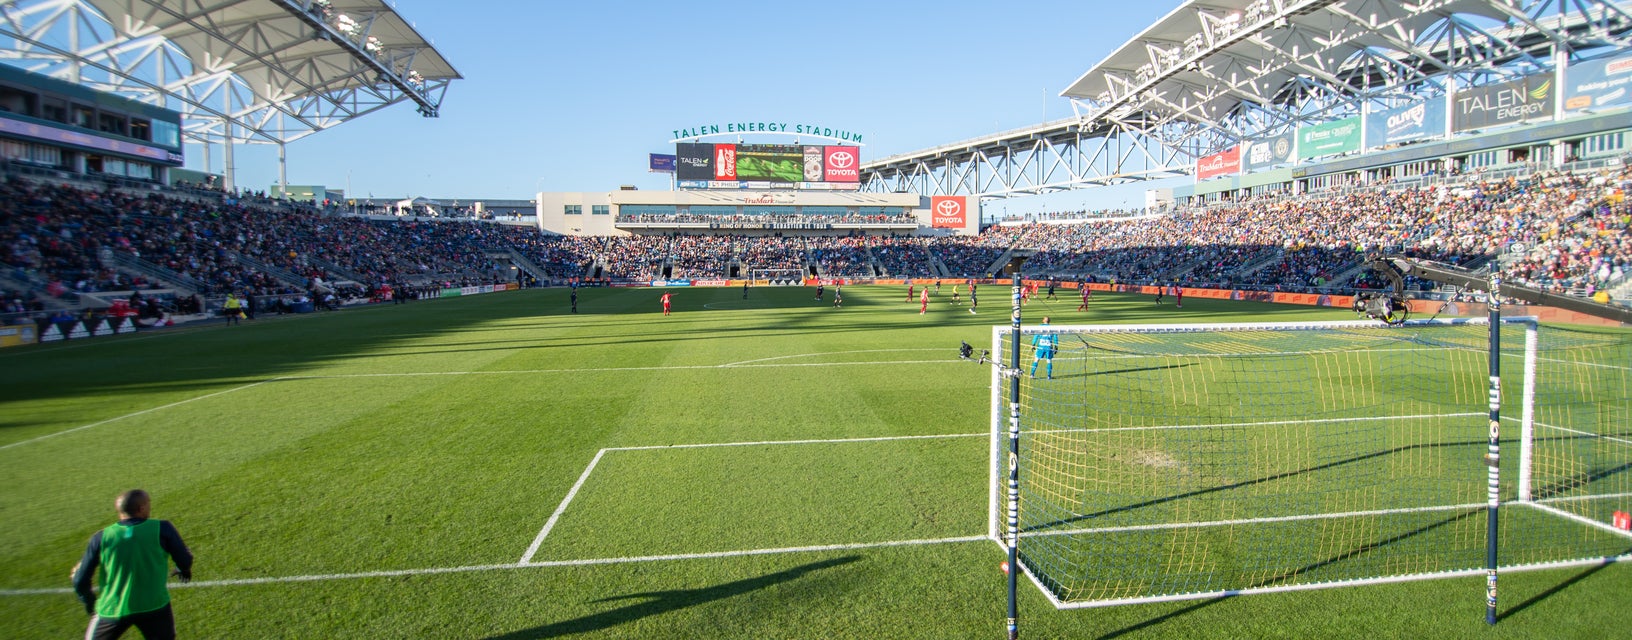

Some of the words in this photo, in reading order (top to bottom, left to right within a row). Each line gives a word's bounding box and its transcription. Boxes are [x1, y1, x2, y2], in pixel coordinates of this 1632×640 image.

[1458, 86, 1527, 115] TALEN
[1387, 103, 1425, 129] OLIVER
[1497, 101, 1547, 120] ENERGY
[673, 125, 720, 140] TALEN
[728, 123, 787, 133] ENERGY
[796, 124, 863, 143] STADIUM
[681, 157, 703, 165] TALEN
[744, 196, 774, 204] TruMark
